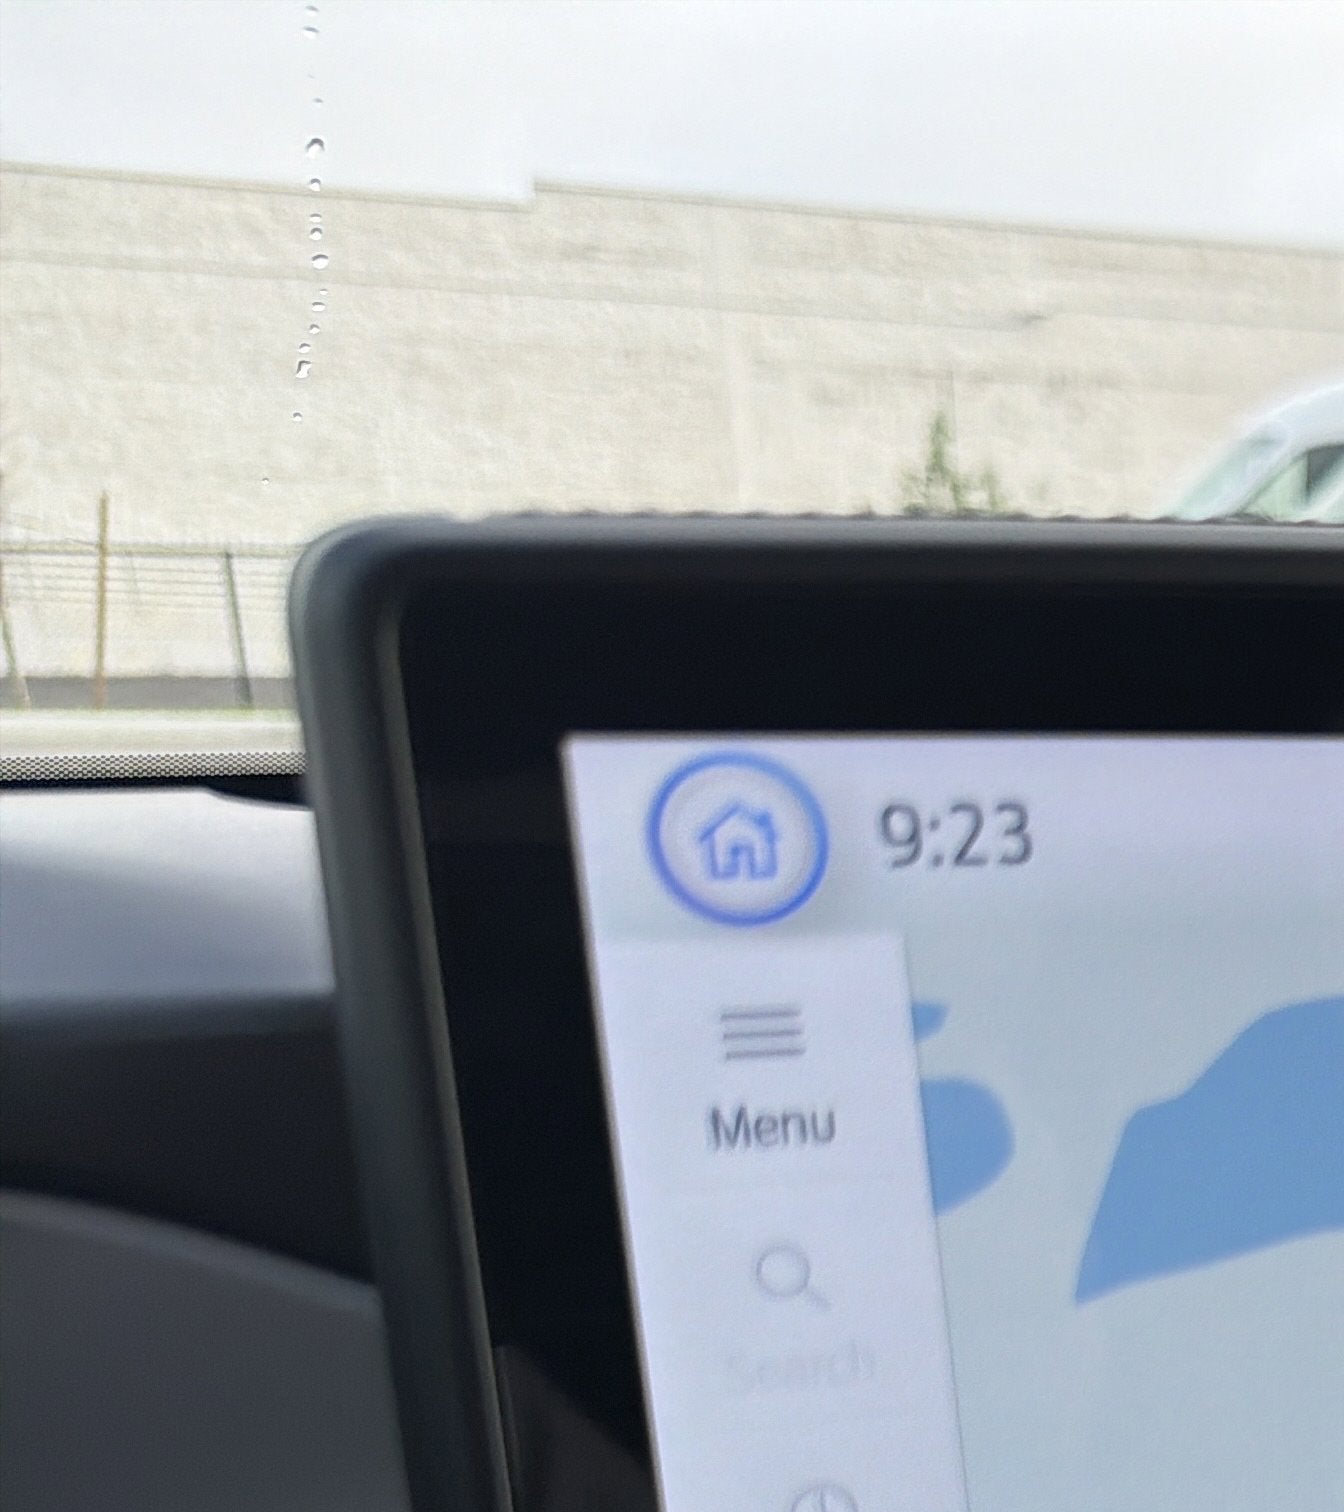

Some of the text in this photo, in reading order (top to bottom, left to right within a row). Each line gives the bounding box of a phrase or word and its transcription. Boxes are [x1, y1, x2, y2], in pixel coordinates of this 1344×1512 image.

[878, 801, 1034, 868] 9:23
[708, 1103, 837, 1152] Menu
[724, 1341, 876, 1395] Search
